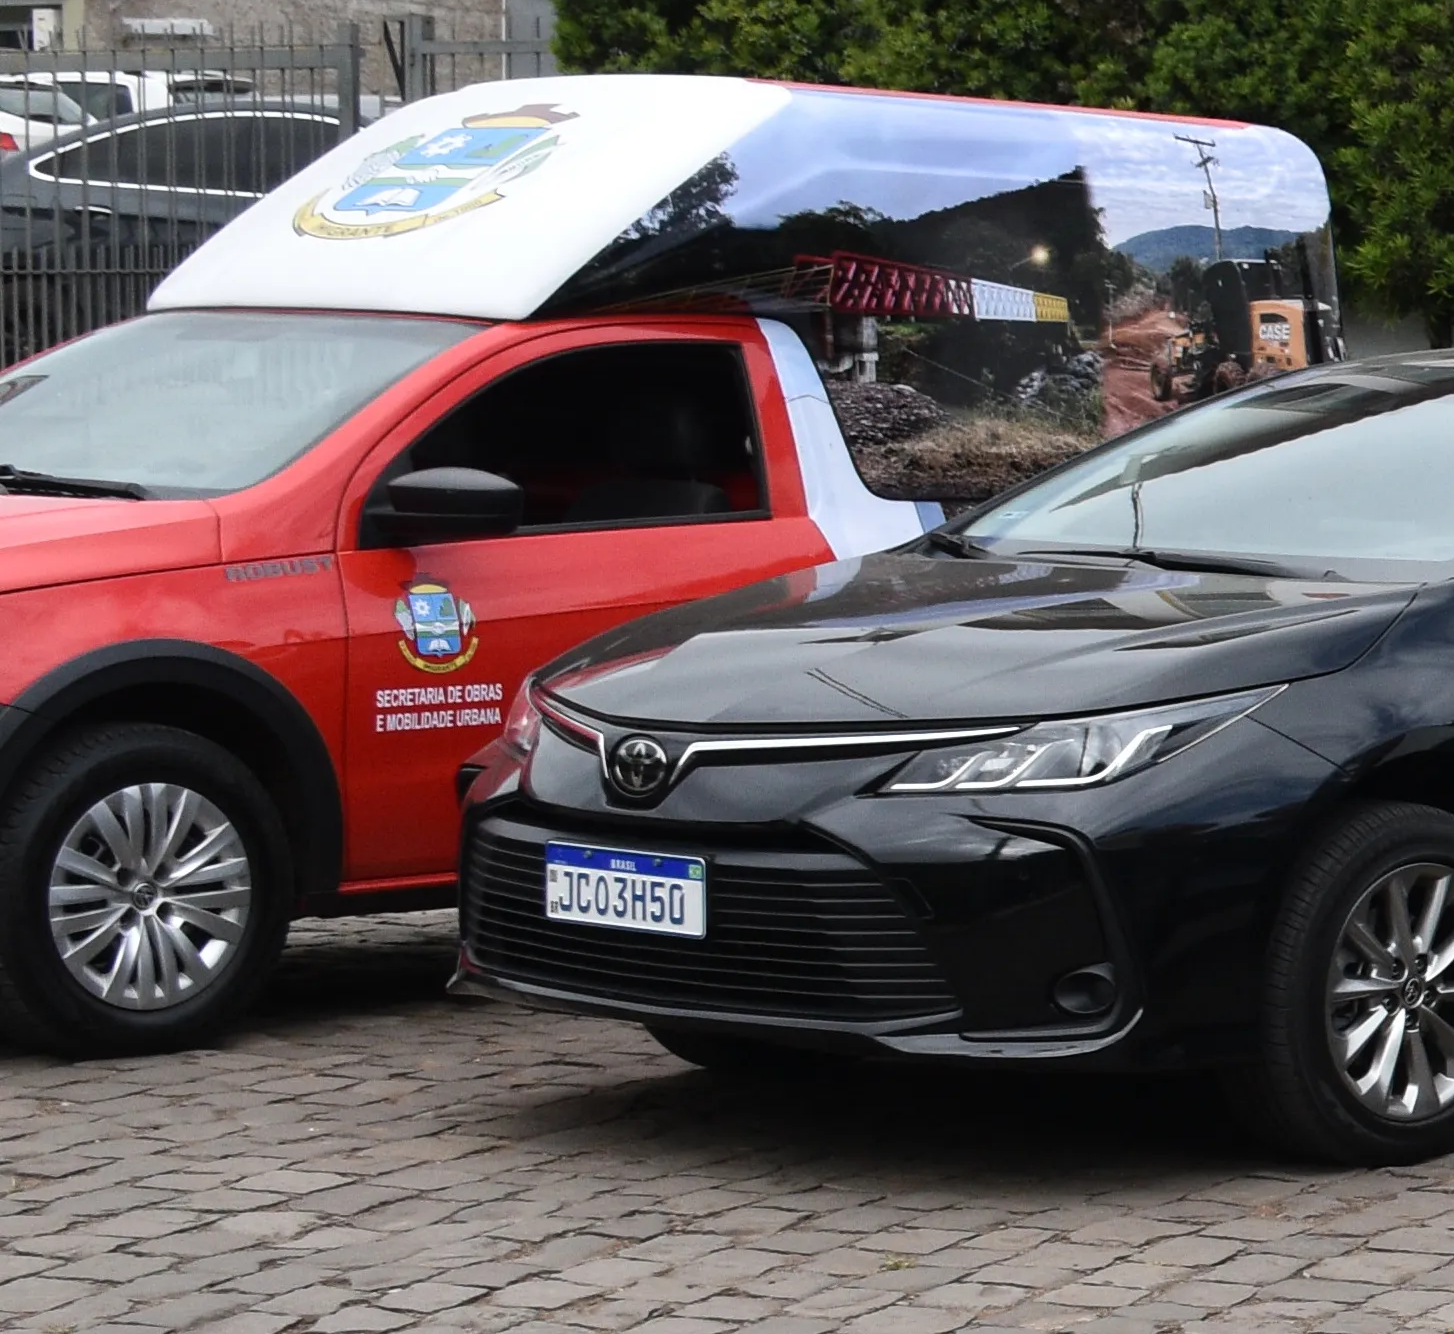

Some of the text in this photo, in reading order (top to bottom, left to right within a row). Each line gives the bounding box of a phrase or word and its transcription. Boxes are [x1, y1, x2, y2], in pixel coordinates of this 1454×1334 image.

[1259, 323, 1290, 340] CASE
[224, 555, 334, 582] ROBUST
[376, 683, 503, 708] SECRETARIA DE OBRAS
[376, 707, 502, 732] E MOBILIDADE URBANA
[610, 858, 637, 872] BRASIL
